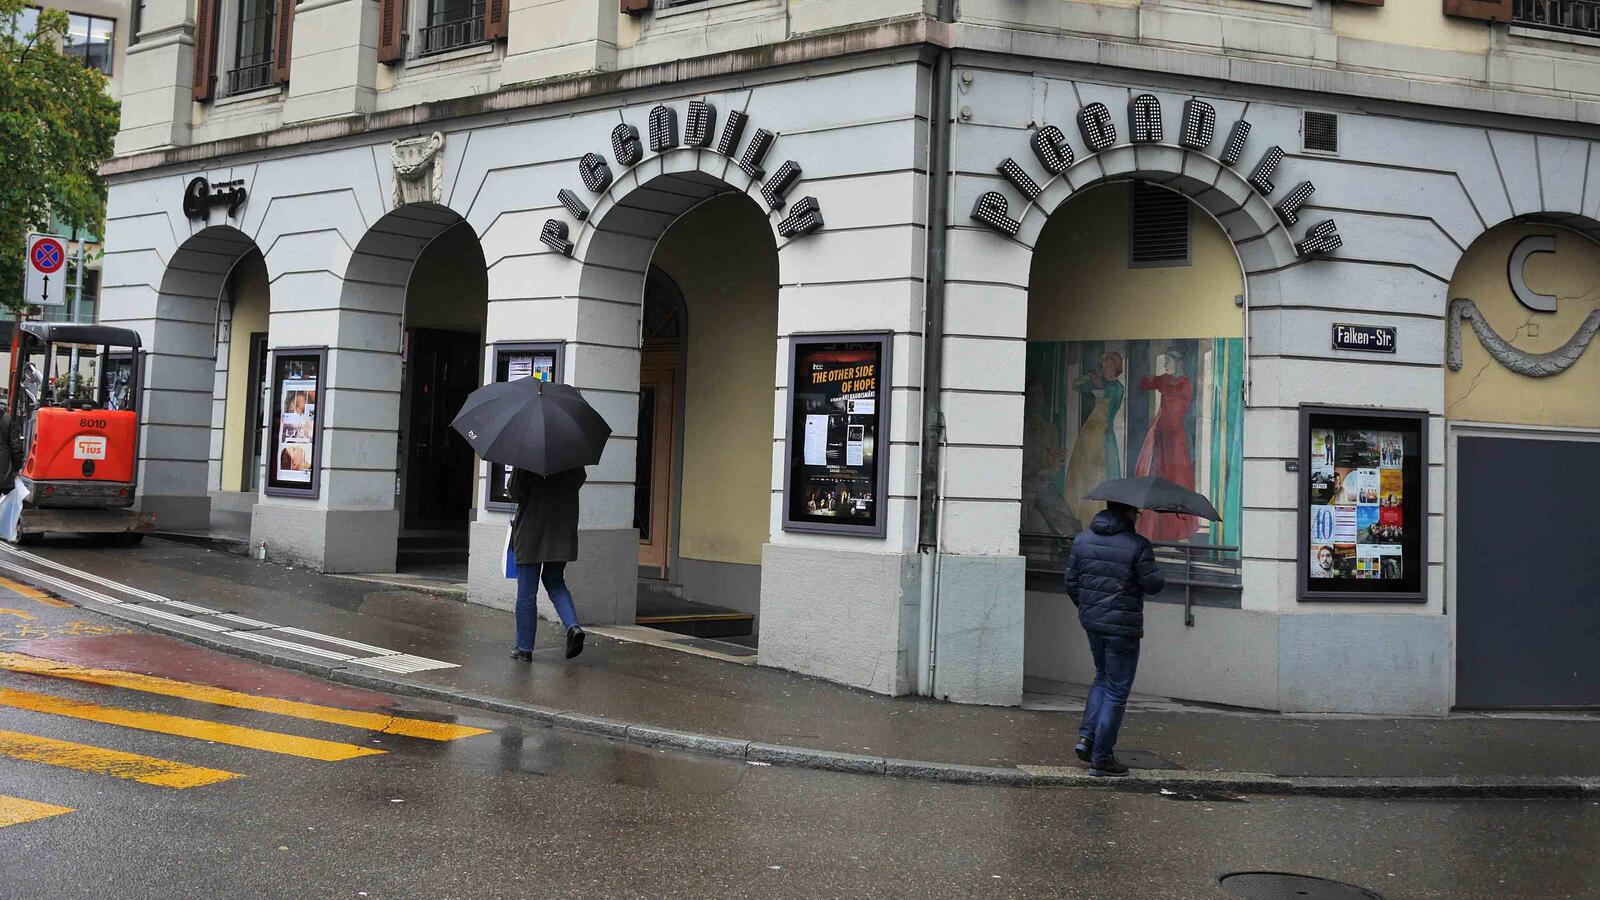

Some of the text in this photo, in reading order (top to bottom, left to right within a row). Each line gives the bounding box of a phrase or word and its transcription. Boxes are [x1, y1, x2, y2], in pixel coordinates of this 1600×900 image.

[539, 100, 825, 256] PICCADILLY
[970, 94, 1343, 255] PICCADILLY
[1507, 235, 1557, 313] C
[812, 372, 828, 384] THE
[829, 367, 854, 382] OTHER
[855, 365, 874, 378] SIDE
[841, 378, 876, 393] OF HOPE
[80, 419, 106, 428] 8010
